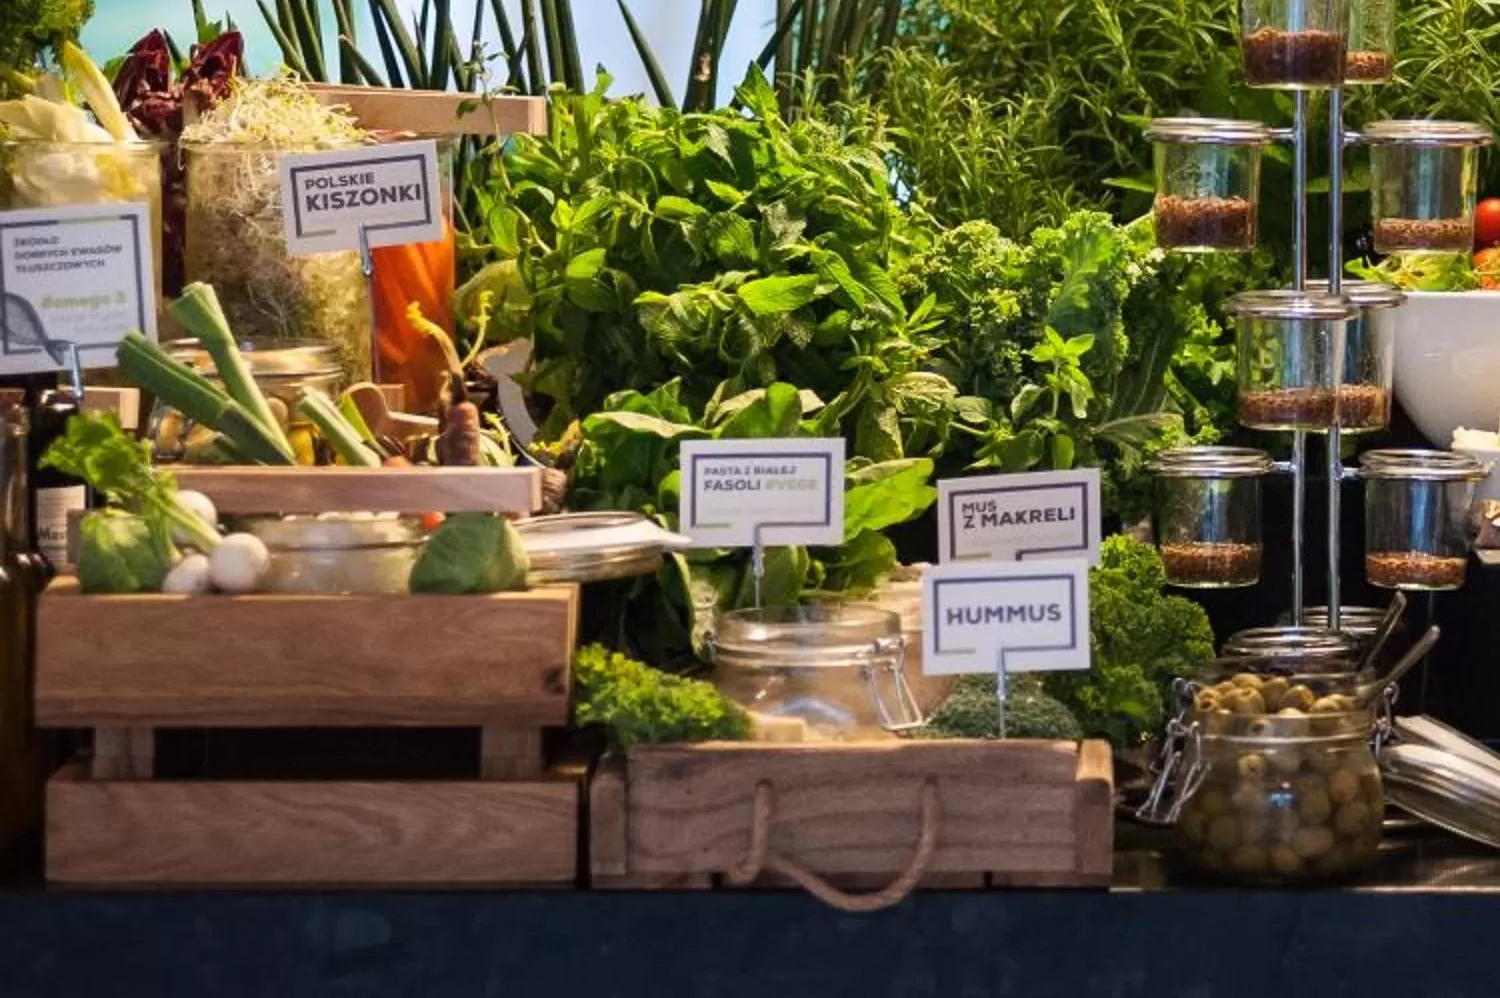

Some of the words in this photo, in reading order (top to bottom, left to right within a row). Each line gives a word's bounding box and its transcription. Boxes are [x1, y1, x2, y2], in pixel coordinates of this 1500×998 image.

[305, 172, 374, 190] POLSKIE
[305, 184, 422, 212] KISZONKI
[704, 465, 739, 476] PASTA
[704, 479, 761, 491] FASOLI
[962, 500, 997, 513] MUS
[963, 515, 976, 529] Z
[981, 506, 1075, 527] MAKRELI
[946, 603, 1062, 625] HUMMUS
